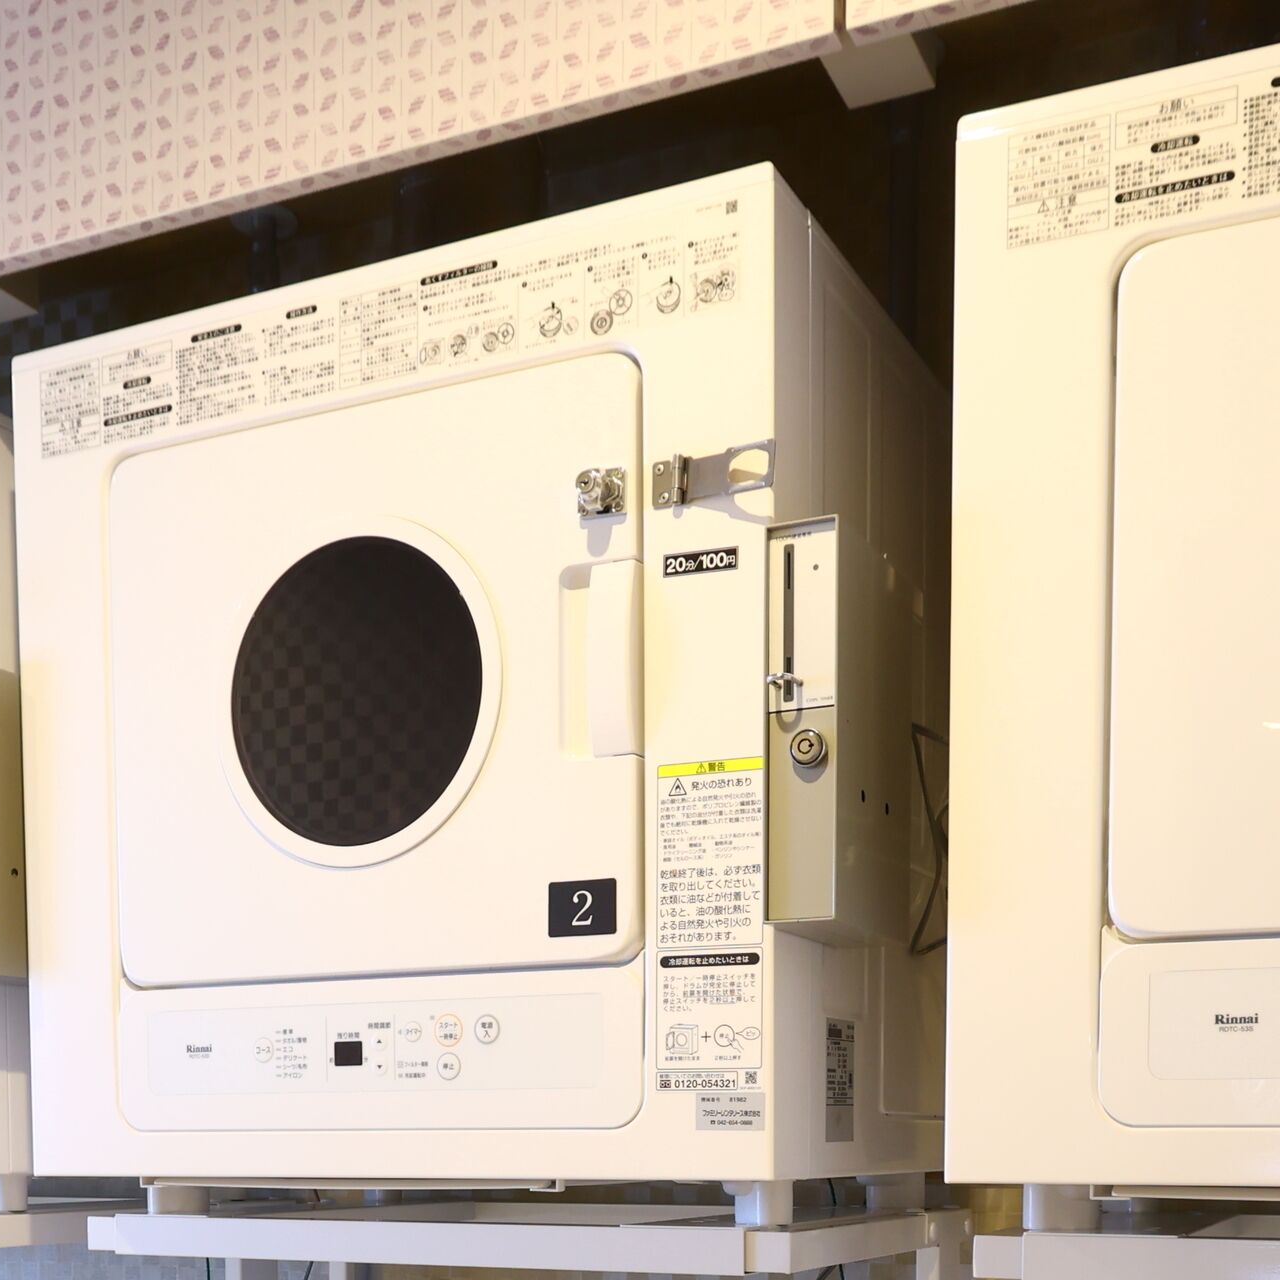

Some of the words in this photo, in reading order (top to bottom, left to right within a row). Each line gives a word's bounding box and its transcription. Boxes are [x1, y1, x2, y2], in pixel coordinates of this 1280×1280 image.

[1160, 98, 1194, 114] お願い
[666, 551, 736, 573] 20分/100円
[708, 762, 725, 772] 警告
[691, 777, 752, 791] 発火の恐れあり
[660, 864, 761, 880] 乾燥終了後は、必ず衣類
[660, 878, 756, 892] を取り出してください。
[660, 890, 760, 905] 衣類に油などが付着して
[572, 890, 593, 926] 2
[660, 904, 751, 918] いると、油の酸化熱に
[660, 917, 752, 930] よる自然発火や引火の
[660, 930, 737, 944] おそれがあります。
[669, 956, 750, 966] 冷却運転を止めたいときは
[1215, 1013, 1259, 1025] Rinnai
[187, 1044, 212, 1053] Rinnai
[674, 1079, 736, 1088] 0120-054321
